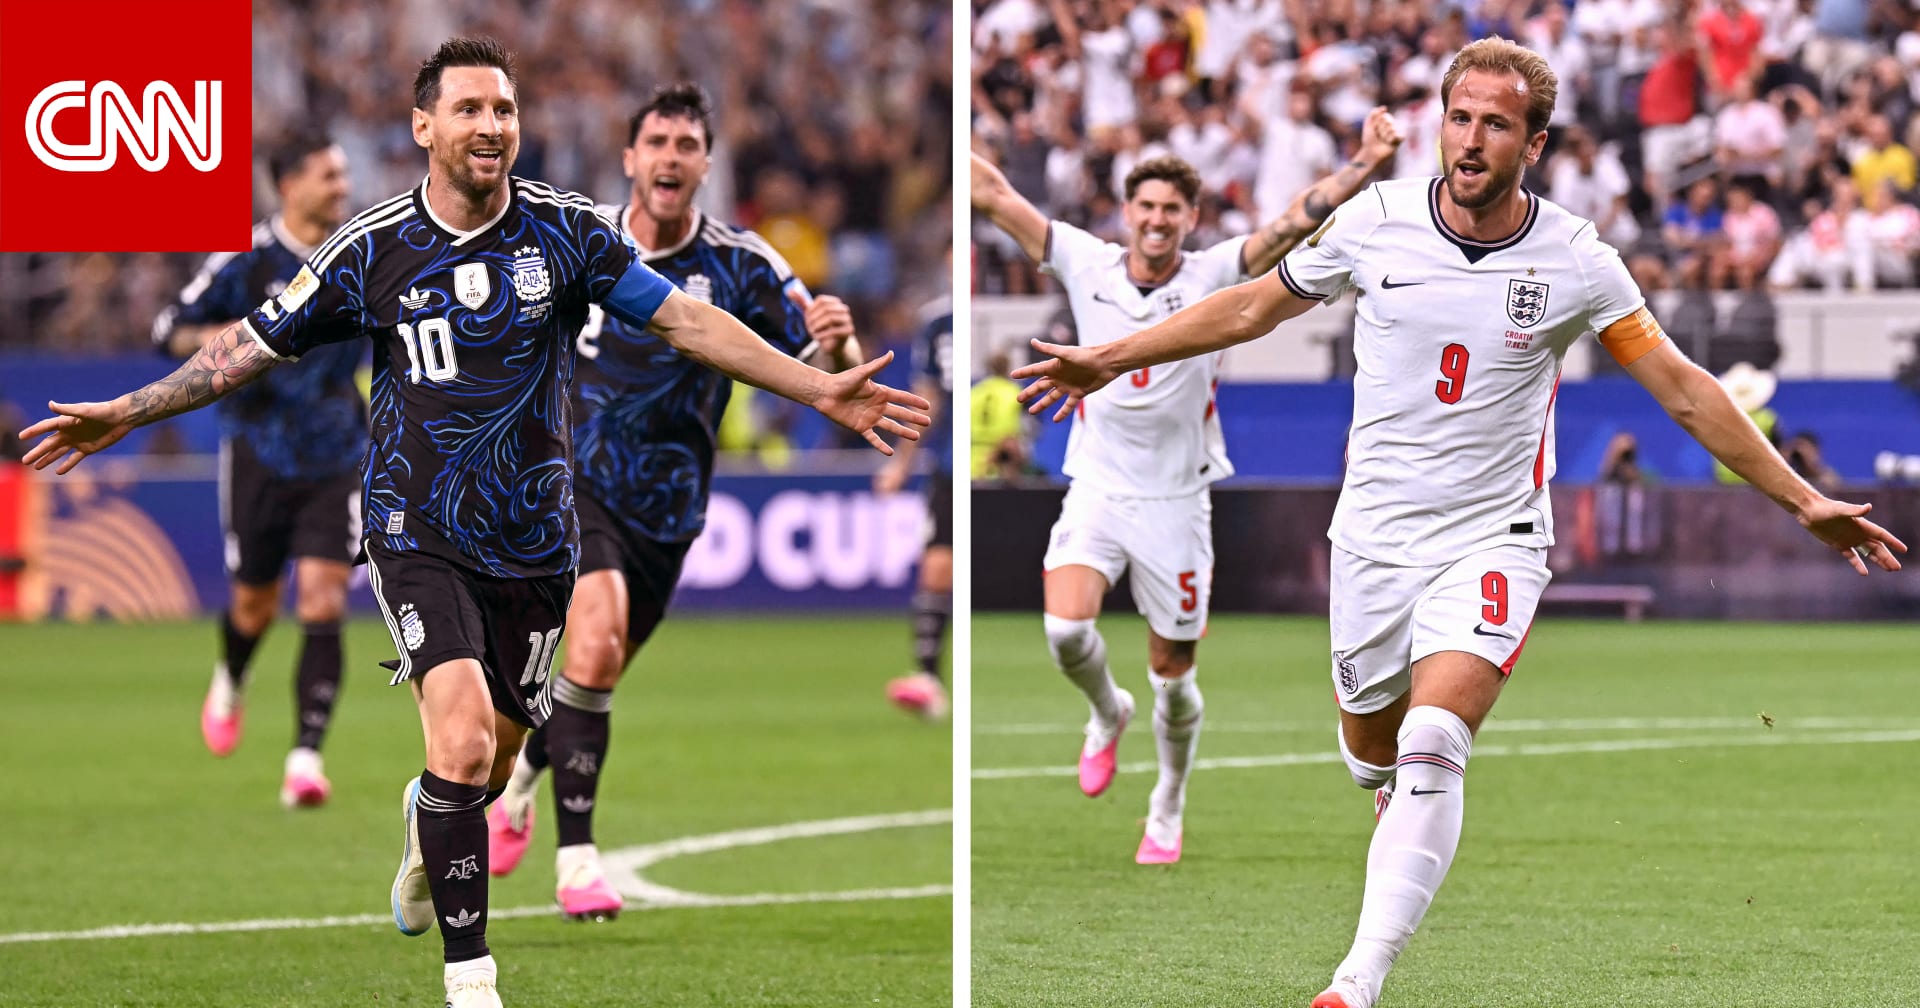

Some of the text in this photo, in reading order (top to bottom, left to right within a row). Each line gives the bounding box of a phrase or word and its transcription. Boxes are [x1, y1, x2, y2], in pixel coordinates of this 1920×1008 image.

[466, 291, 481, 299] FIFA
[396, 317, 459, 385] 10
[1504, 330, 1534, 342] CROATIA
[1434, 342, 1470, 405] 9
[757, 490, 930, 589] CUP
[1178, 571, 1198, 613] 5
[1481, 571, 1508, 626] 9
[519, 625, 562, 687] 10
[444, 854, 480, 881] AFA
